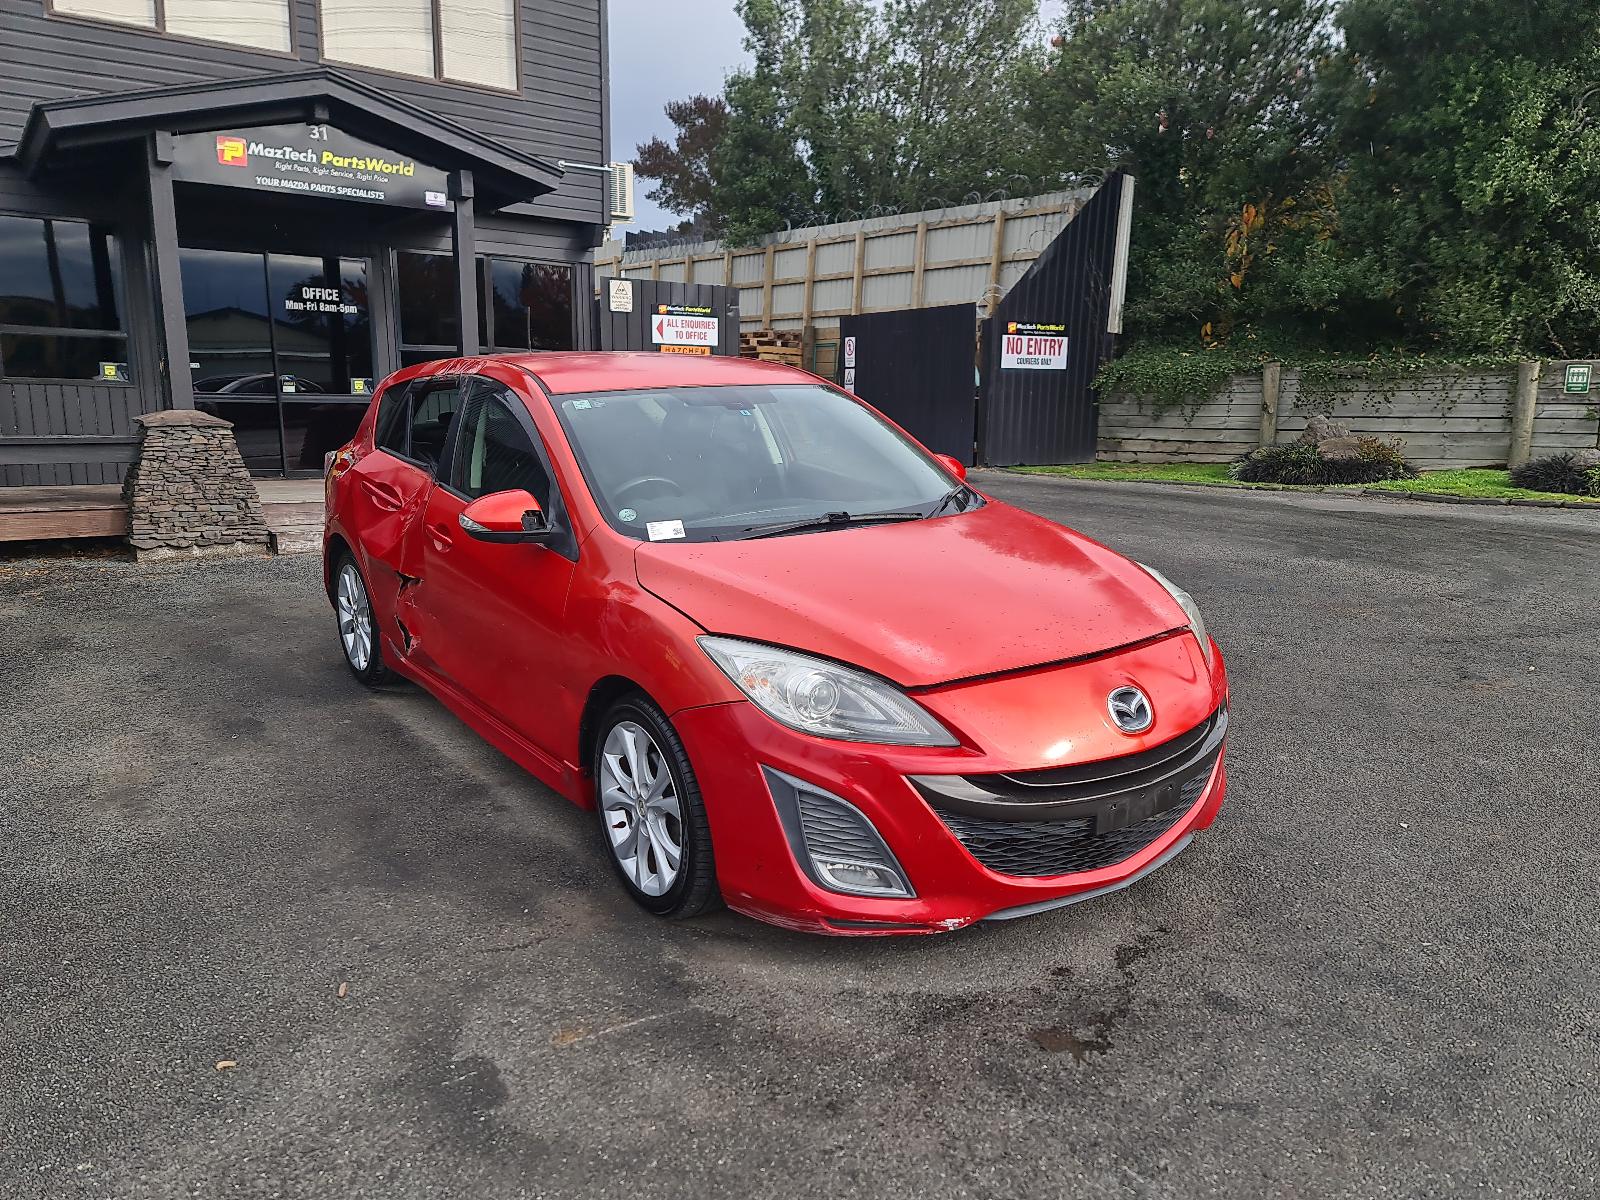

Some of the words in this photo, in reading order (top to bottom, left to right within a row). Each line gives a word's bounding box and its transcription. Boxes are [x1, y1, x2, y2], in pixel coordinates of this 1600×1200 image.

[309, 126, 328, 141] 31
[248, 142, 317, 162] MazTech
[321, 151, 415, 177] PartsWorld
[275, 161, 292, 172] Right
[312, 166, 329, 176] Right
[330, 168, 355, 179] Service,
[356, 171, 372, 182] Right
[373, 174, 389, 183] Price
[255, 176, 279, 187] YOUR
[280, 179, 309, 191] MAZDA
[310, 183, 336, 194] PARTS
[336, 186, 385, 200] SPECIALISTS
[302, 287, 340, 301] OFFICE
[285, 300, 318, 311] Mon-Fri
[319, 302, 358, 314] 8am-5pm
[666, 319, 679, 328] ALL
[680, 320, 716, 330] ENQUIRIES
[675, 330, 684, 340] TO
[685, 331, 708, 341] OFFICE
[665, 346, 706, 355] HAZCHEM
[1006, 336, 1023, 355] NO
[1026, 337, 1064, 356] ENTRY
[1016, 357, 1040, 365] COURIERS
[1041, 358, 1052, 366] ONLY
